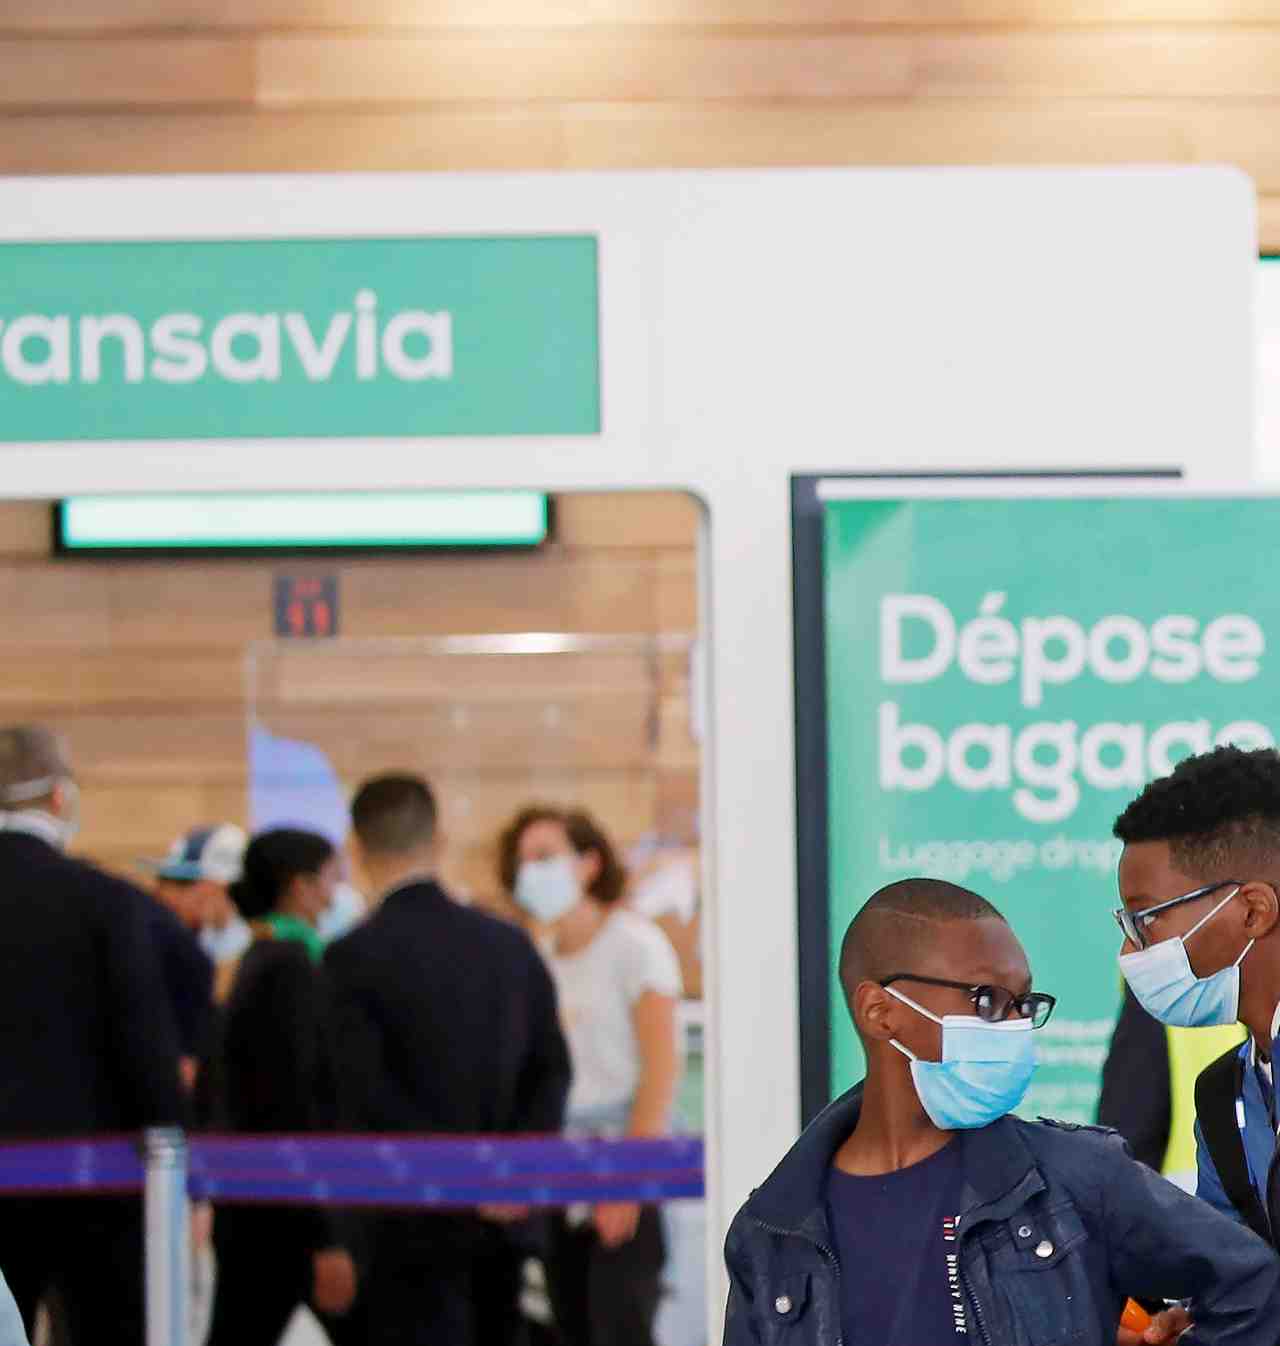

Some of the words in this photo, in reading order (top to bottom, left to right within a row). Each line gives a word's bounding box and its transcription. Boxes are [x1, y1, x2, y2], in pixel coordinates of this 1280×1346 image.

[0, 289, 454, 384] ansavia
[878, 591, 1267, 708] Dépose
[878, 836, 1034, 882] Luggage
